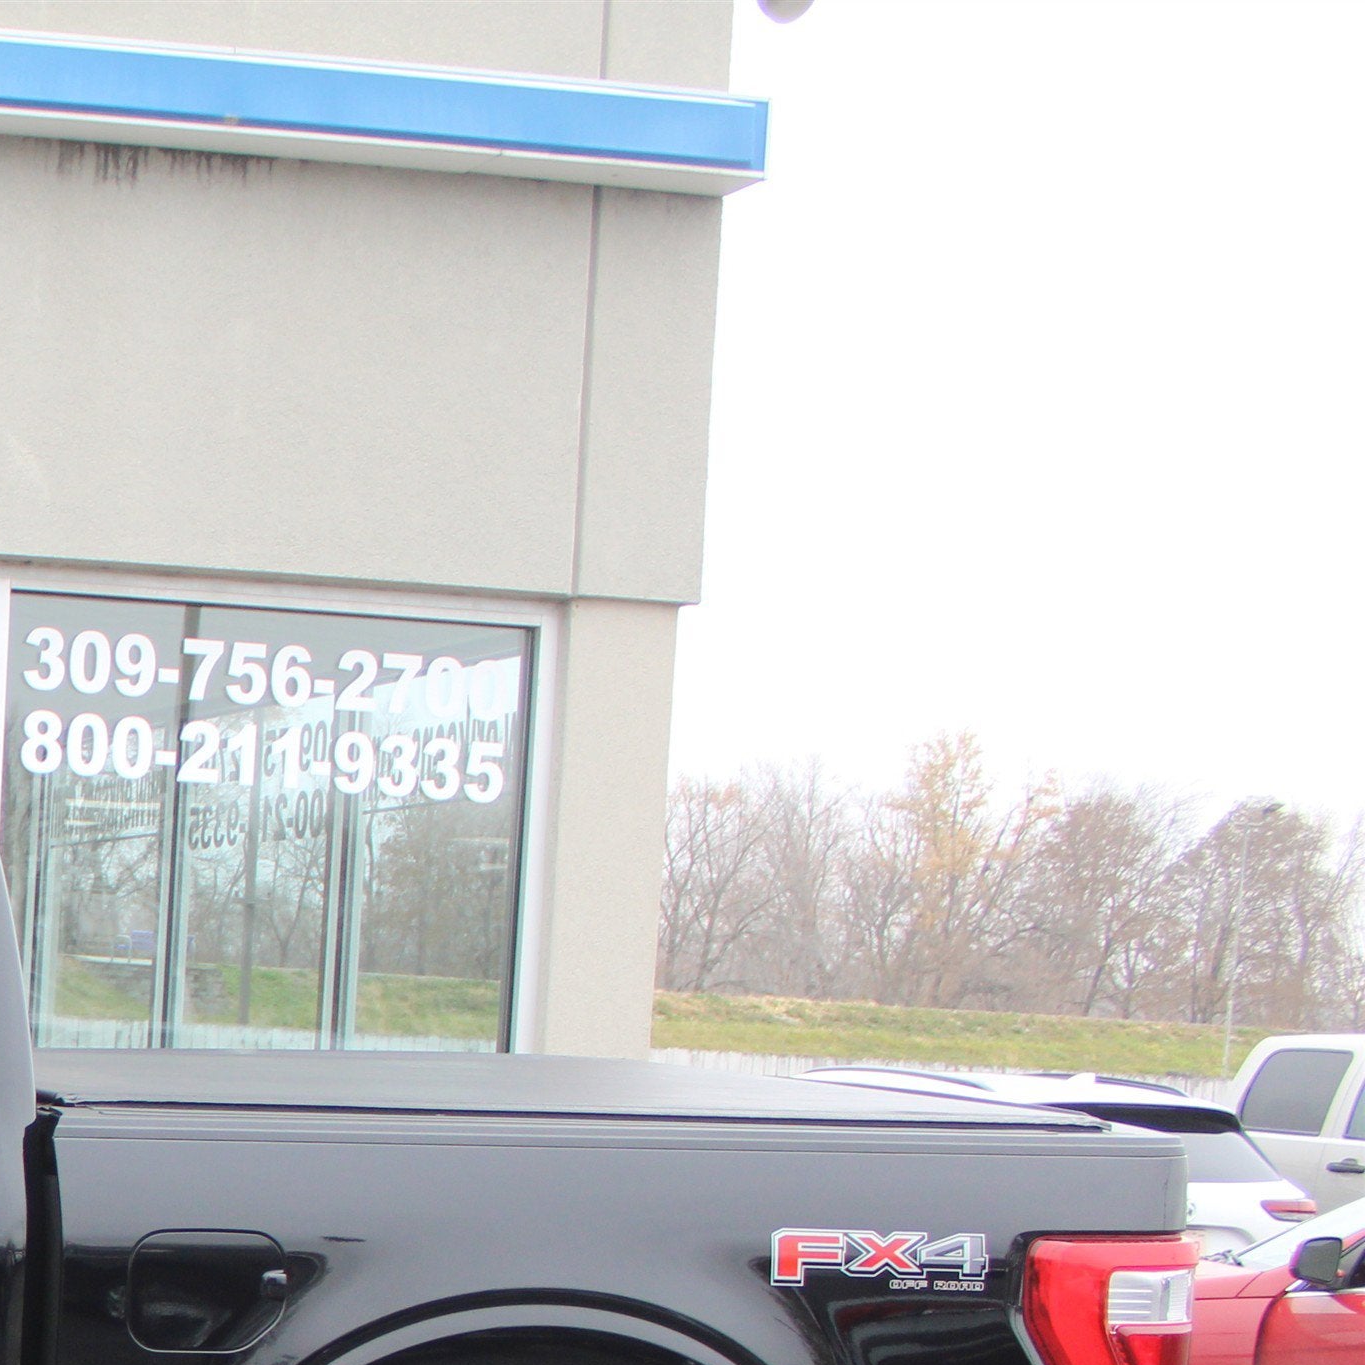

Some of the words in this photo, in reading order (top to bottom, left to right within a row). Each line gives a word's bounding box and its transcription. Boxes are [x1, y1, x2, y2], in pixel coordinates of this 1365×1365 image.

[19, 709, 506, 804] 800-211-9335
[771, 1228, 989, 1286] FX4
[889, 1279, 928, 1290] OFF
[933, 1280, 985, 1291] ROAD
